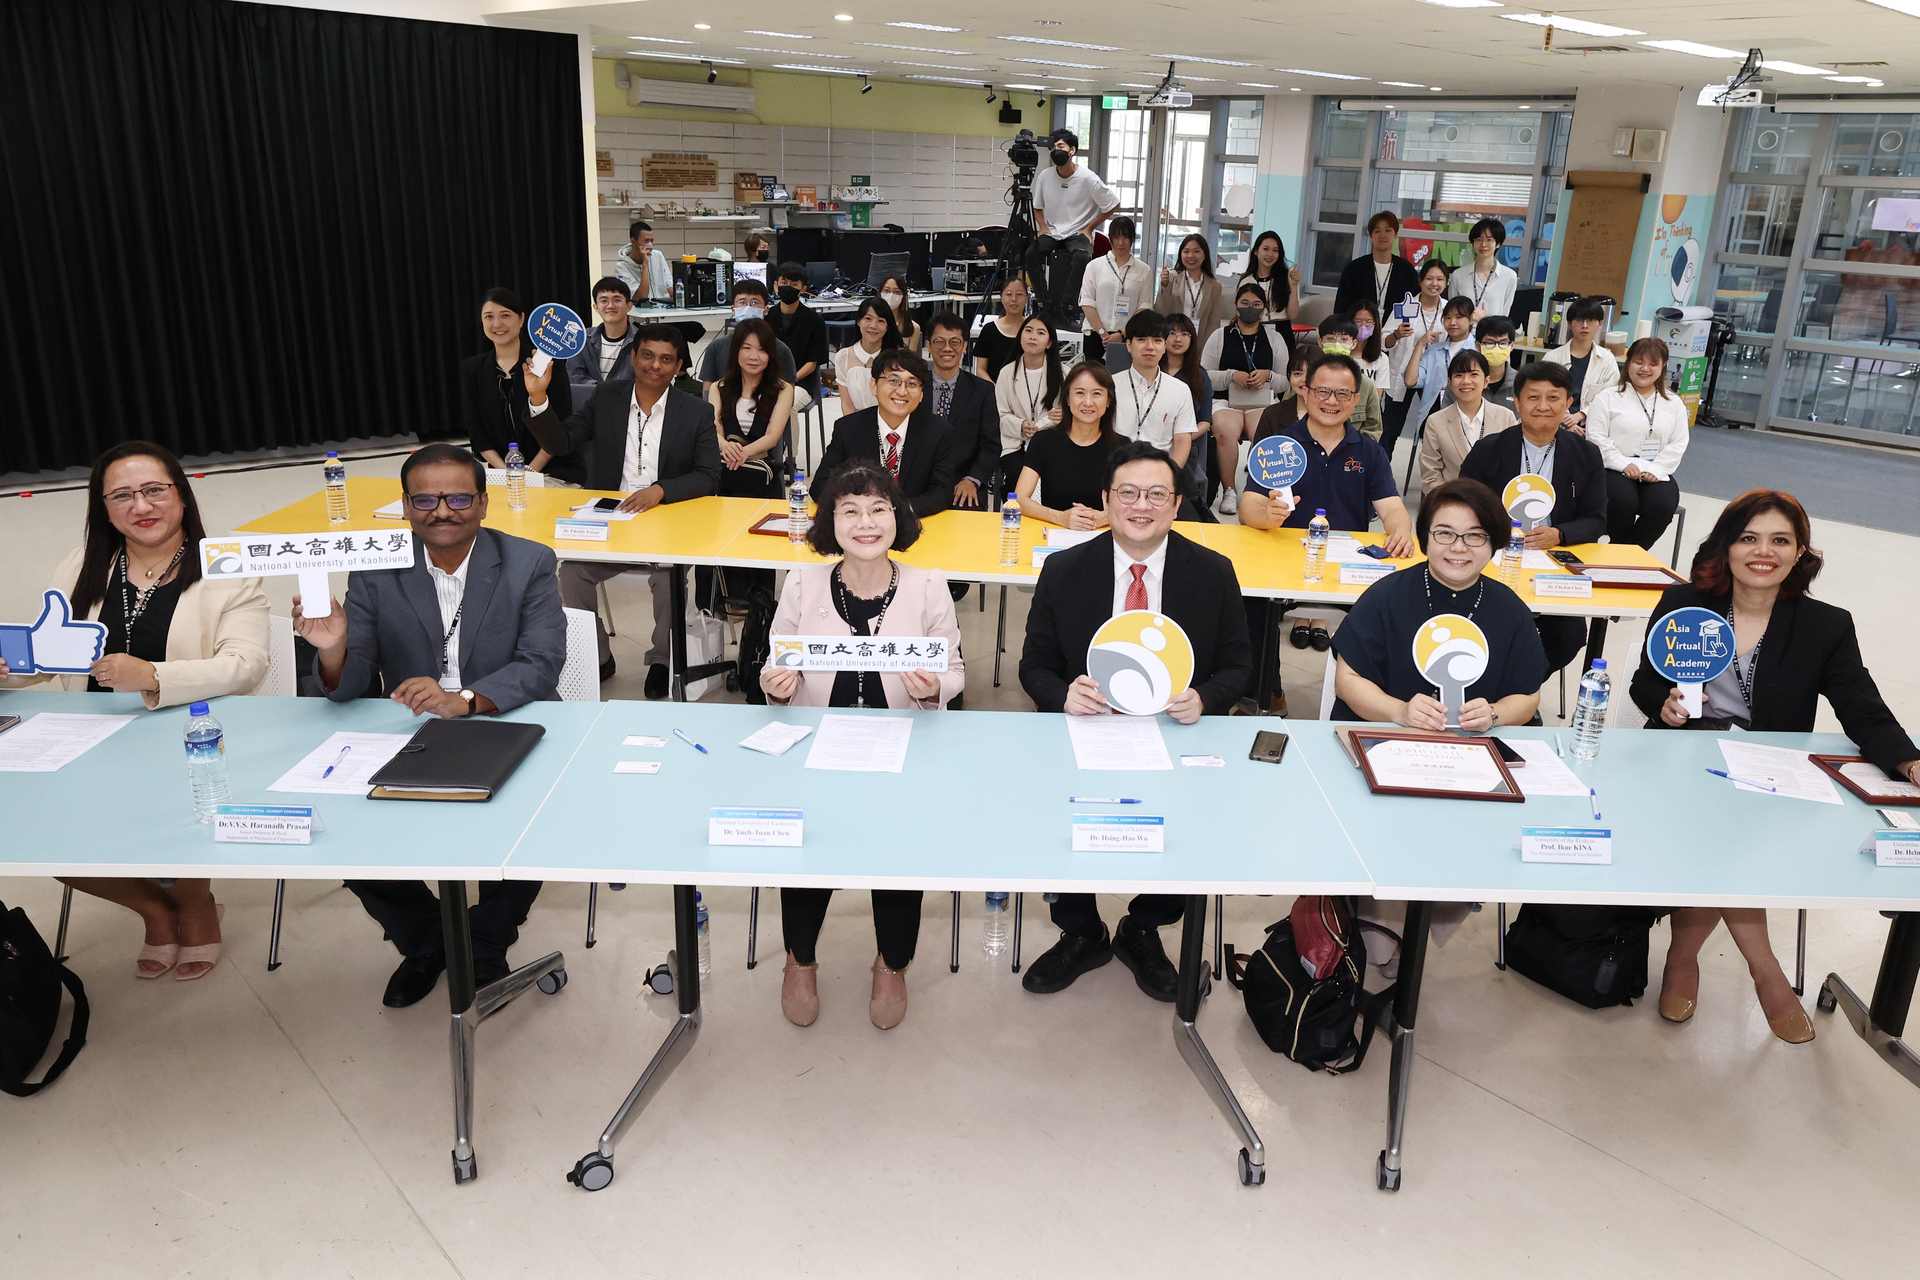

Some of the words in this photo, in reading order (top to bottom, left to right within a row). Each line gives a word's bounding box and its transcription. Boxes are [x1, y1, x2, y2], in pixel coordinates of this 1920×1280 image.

[545, 307, 561, 322] Asia
[542, 316, 563, 337] Virtual
[534, 328, 563, 351] Academy
[1257, 446, 1273, 457] Asia
[1258, 458, 1284, 468] Virtual
[1262, 470, 1293, 480] Academy
[247, 533, 408, 558] 國立高雄大學
[250, 560, 291, 571] National
[295, 558, 344, 569] University
[348, 557, 357, 565] of
[361, 555, 409, 564] Kaohsiung
[1665, 619, 1690, 632] Asia
[808, 642, 944, 658] 國立高雄大學
[1665, 636, 1700, 650] Virtual
[846, 659, 886, 668] University
[901, 660, 943, 668] Kaohsiung
[1664, 653, 1711, 669] Academy
